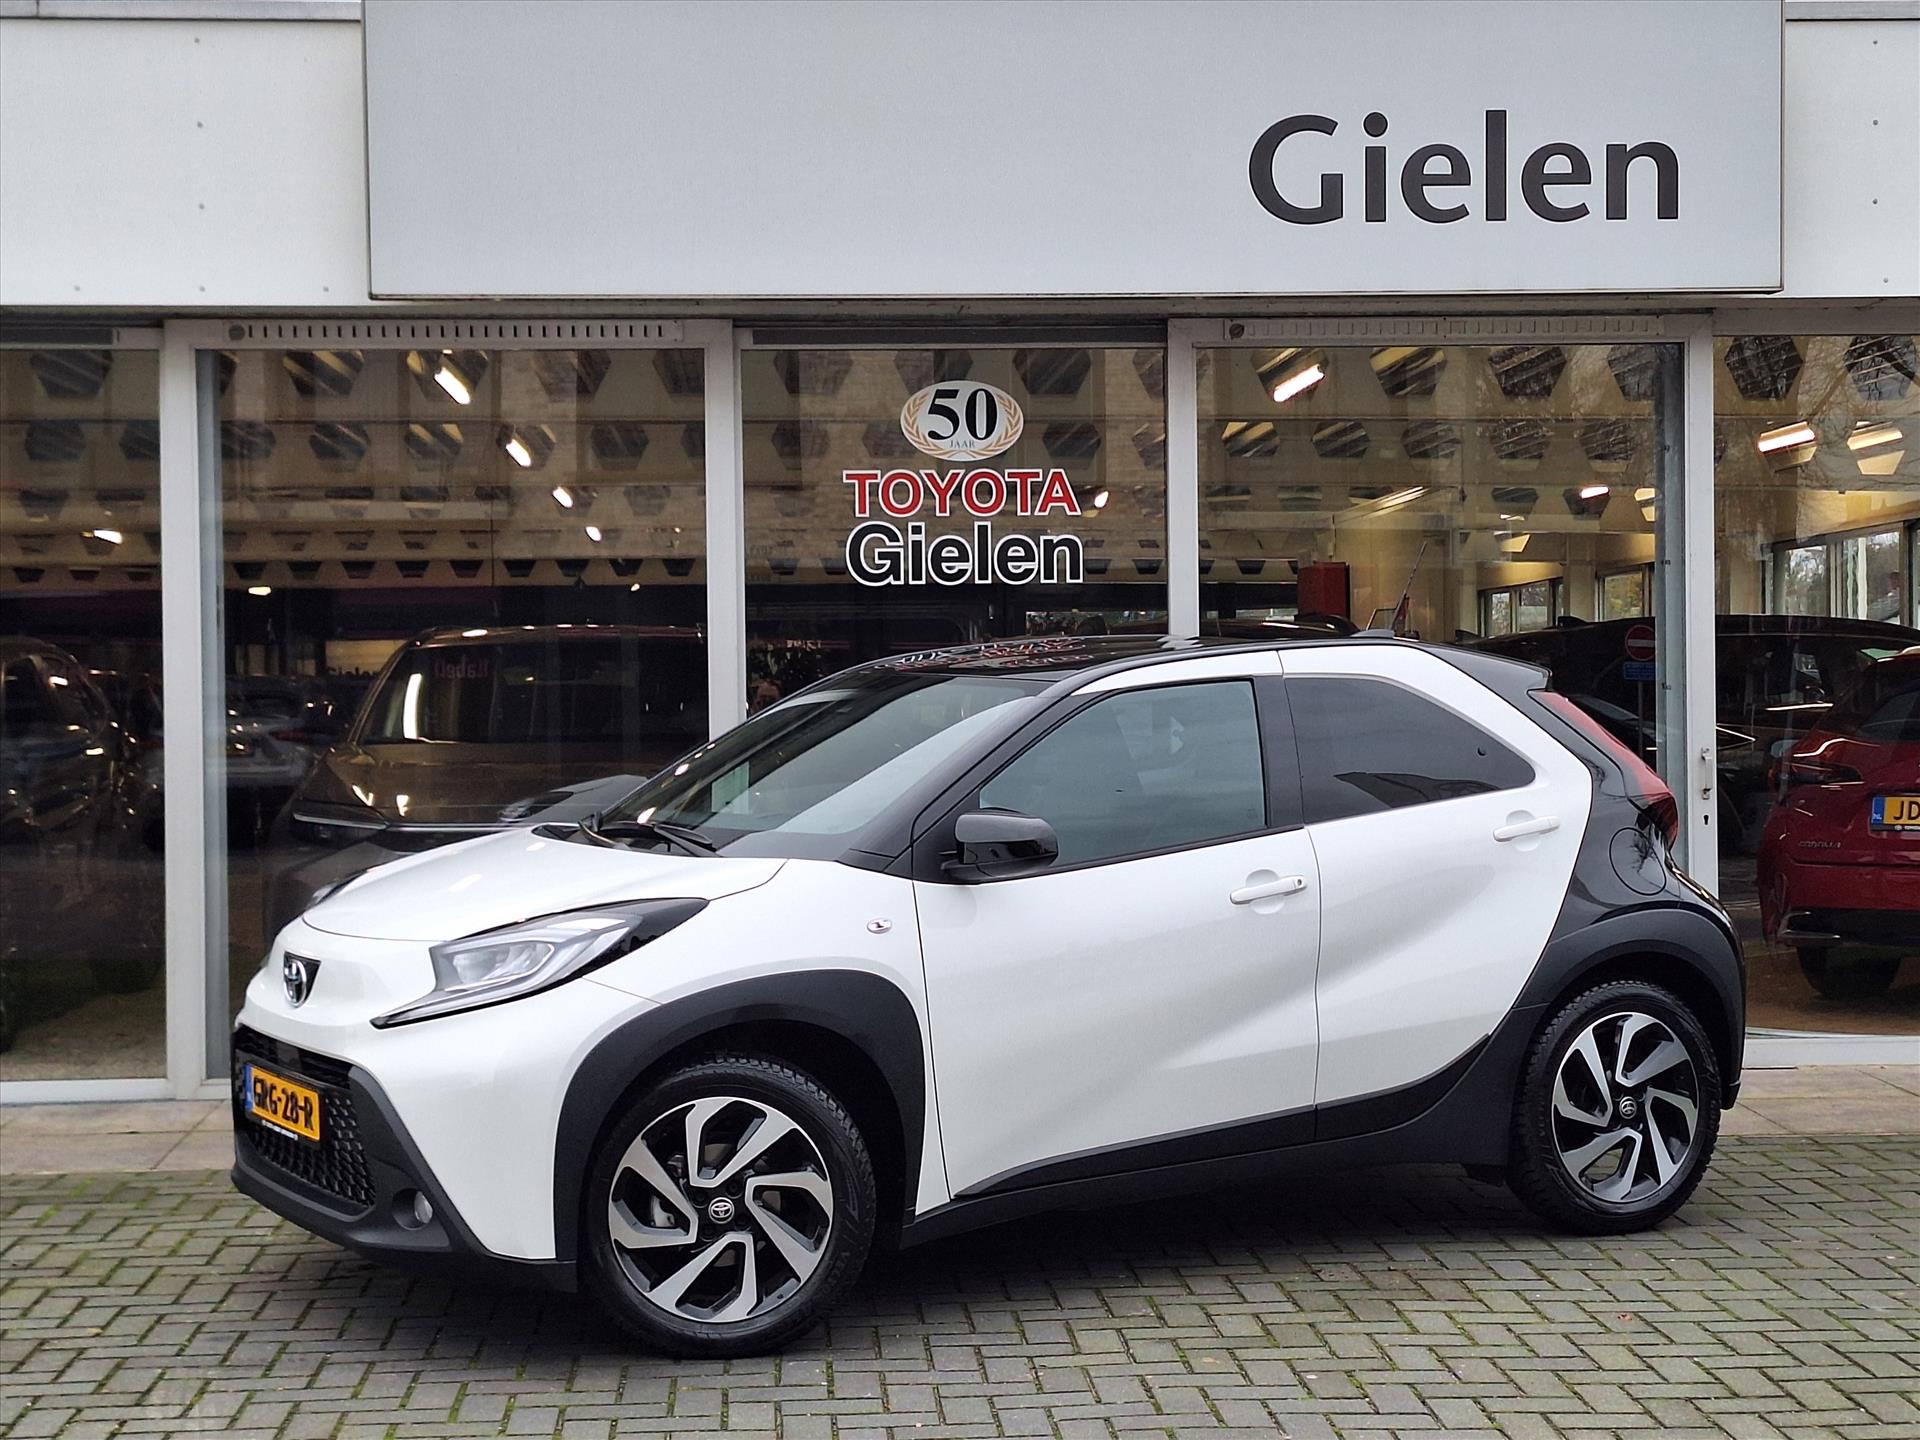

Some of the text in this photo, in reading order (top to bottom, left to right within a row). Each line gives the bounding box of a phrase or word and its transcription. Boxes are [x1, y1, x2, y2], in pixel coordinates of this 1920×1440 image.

[1248, 109, 1680, 225] Gielen
[927, 388, 998, 441] 50
[950, 440, 976, 449] JAAR
[843, 469, 1082, 517] TOYOTA
[846, 520, 1083, 587] Gielen
